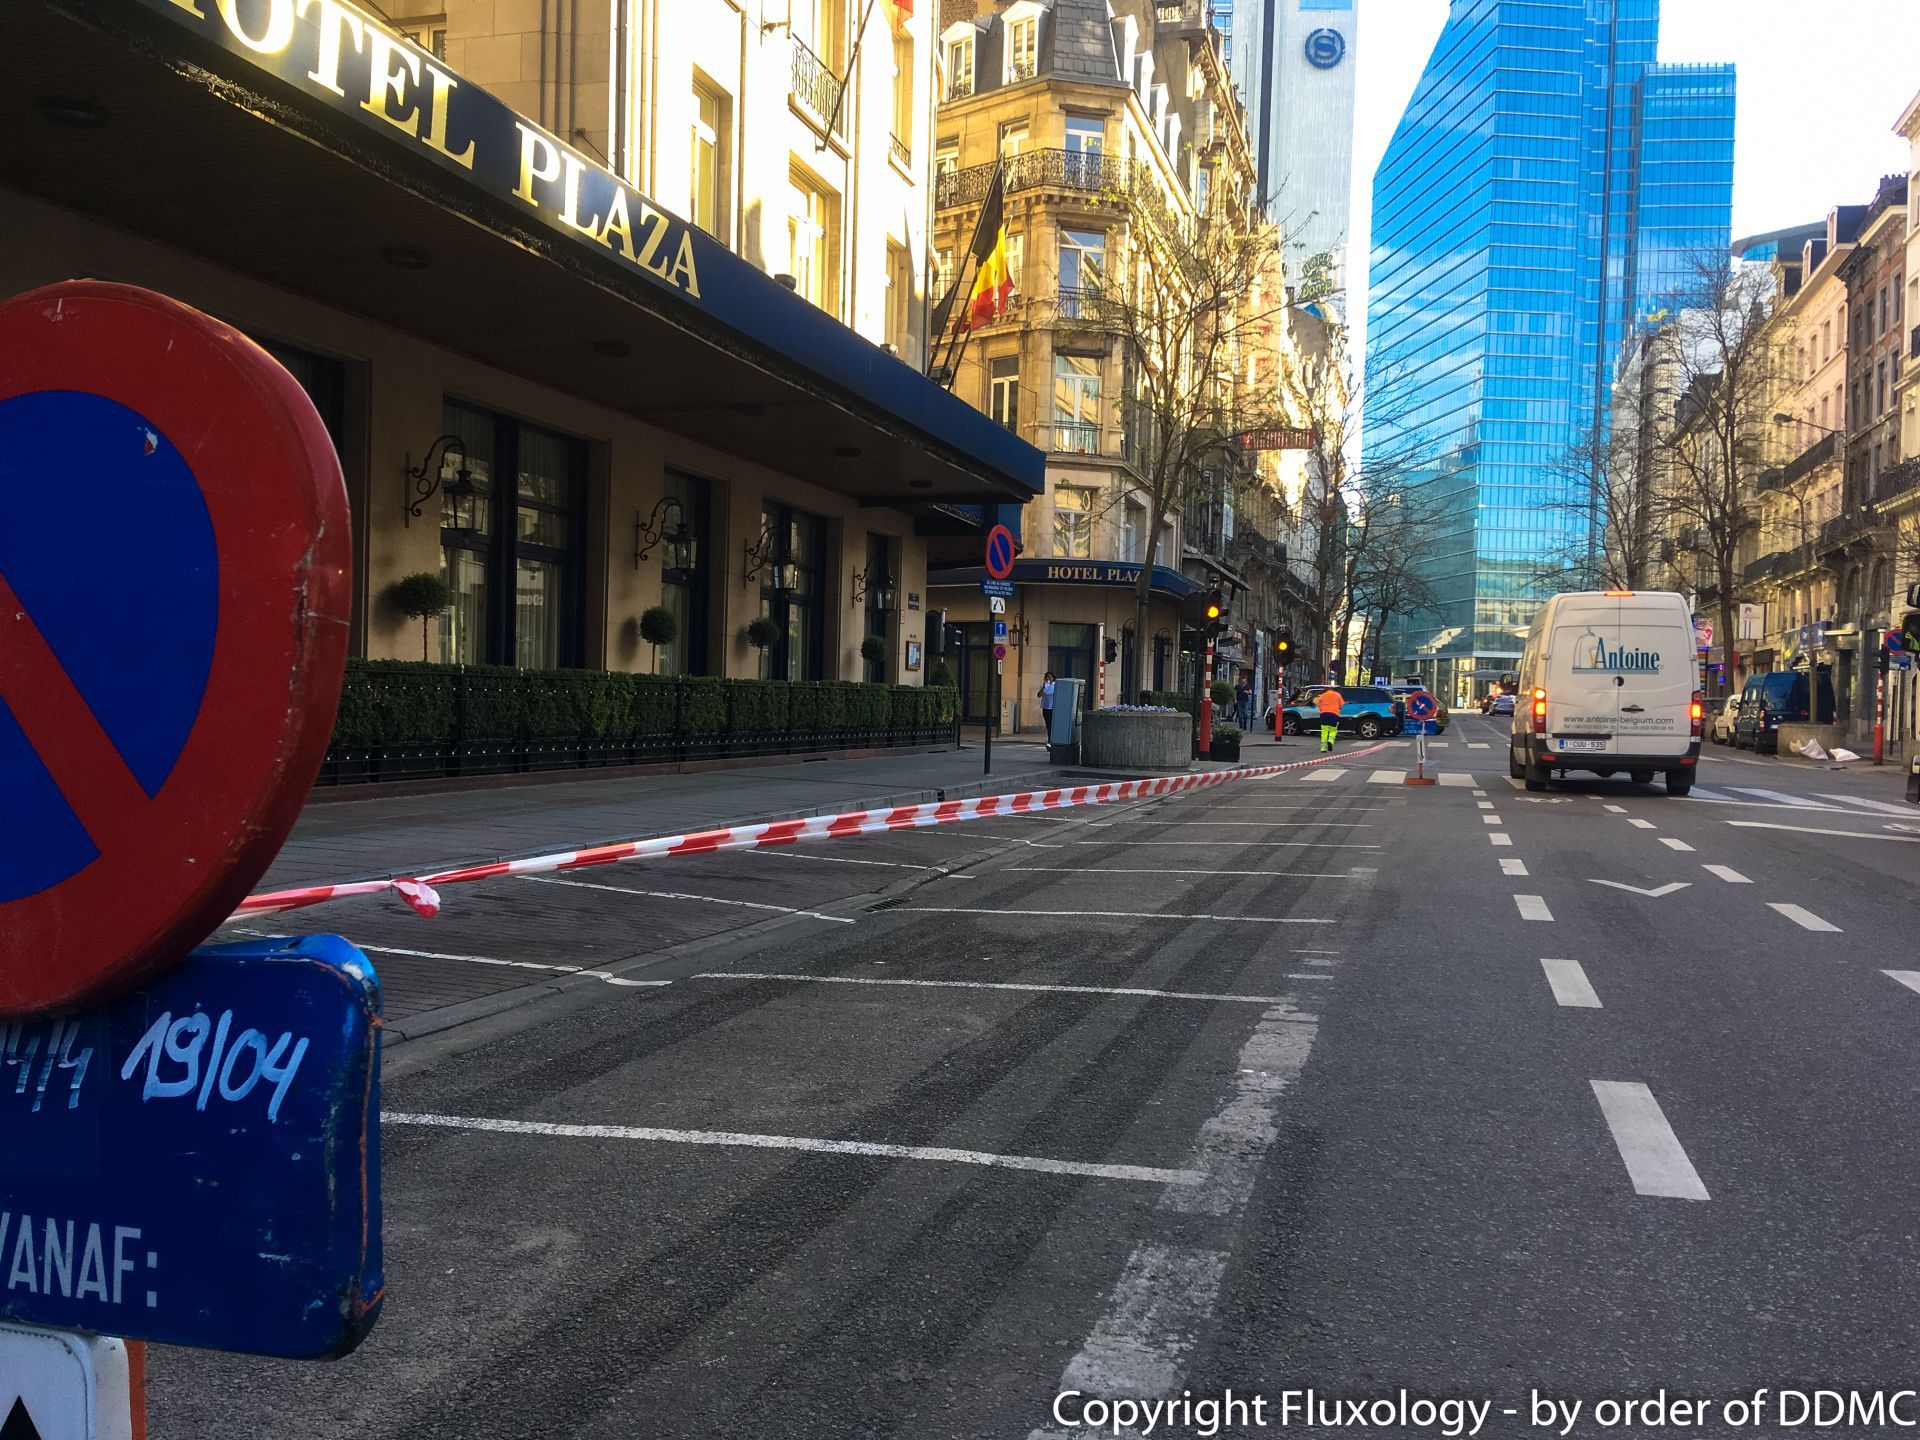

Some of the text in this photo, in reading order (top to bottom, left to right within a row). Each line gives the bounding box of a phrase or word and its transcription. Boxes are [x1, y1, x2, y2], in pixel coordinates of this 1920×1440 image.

[512, 121, 701, 299] PLAZA
[1048, 566, 1142, 582] HOTEL PLAZ
[1594, 637, 1660, 669] Antoine
[1563, 716, 1674, 726] www.antoine-belgium.com
[120, 1009, 310, 1123] 19/04
